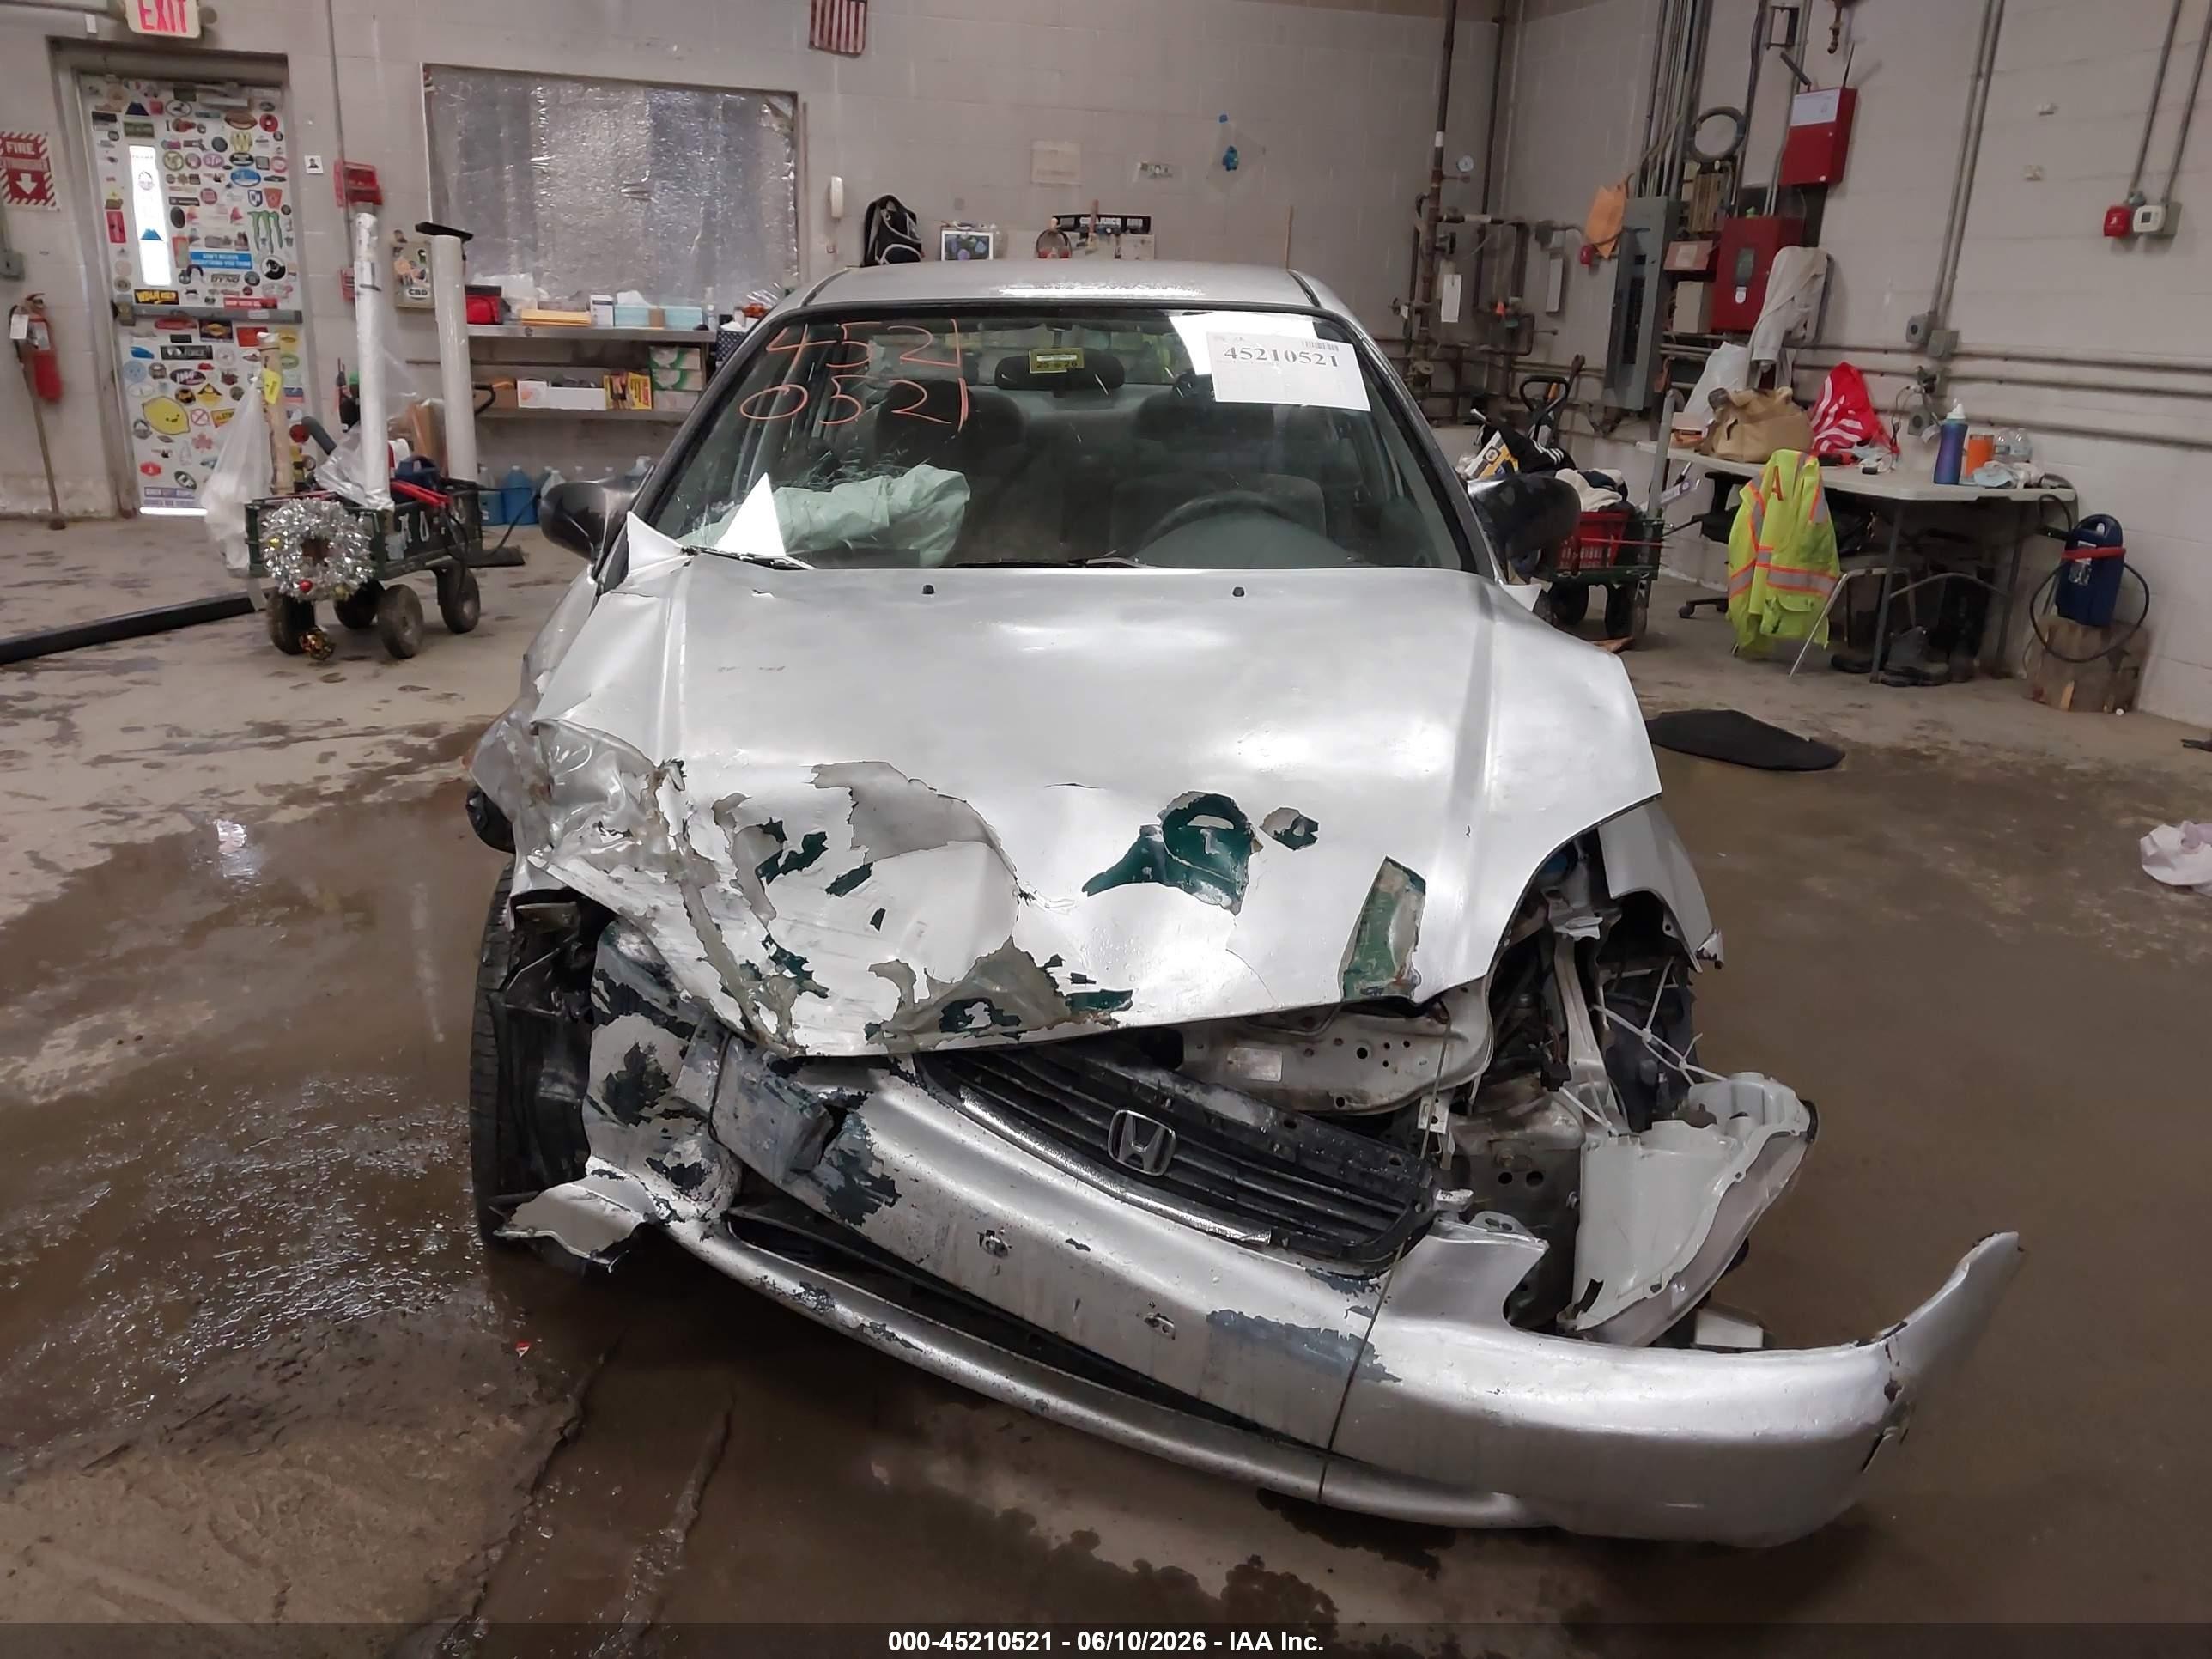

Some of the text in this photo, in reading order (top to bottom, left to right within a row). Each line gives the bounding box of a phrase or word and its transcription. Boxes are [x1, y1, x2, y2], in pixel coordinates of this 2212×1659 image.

[138, 0, 187, 33] EXIT
[5, 142, 35, 155] FIRE
[408, 288, 428, 296] CBD
[766, 319, 963, 386] 4521
[1224, 346, 1339, 368] 45210521
[739, 376, 969, 432] 0521
